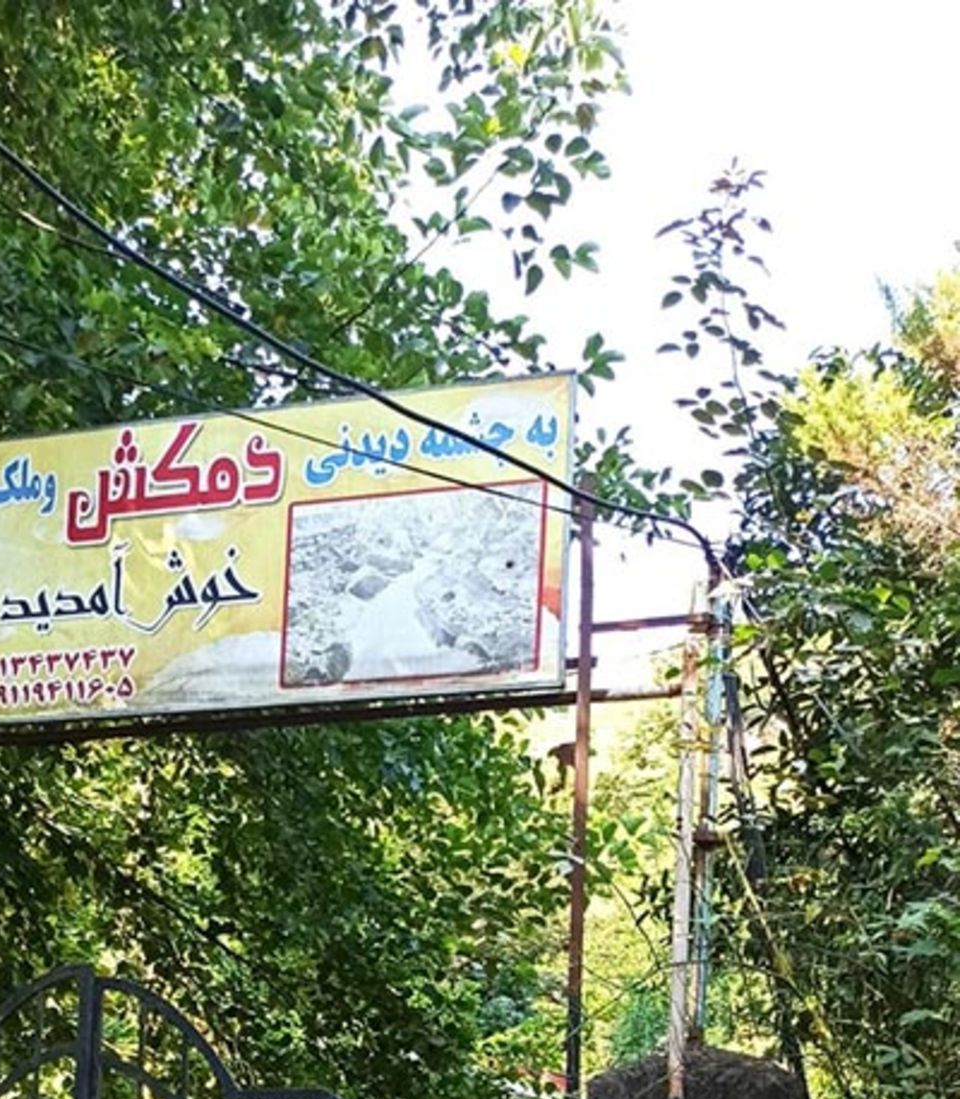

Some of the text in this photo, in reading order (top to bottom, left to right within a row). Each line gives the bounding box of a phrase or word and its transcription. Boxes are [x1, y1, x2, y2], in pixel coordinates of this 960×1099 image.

[305, 421, 410, 486] دیدنی
[526, 414, 559, 458] به
[66, 423, 283, 542] دمکش
[0, 541, 259, 633] خوش آمدید
